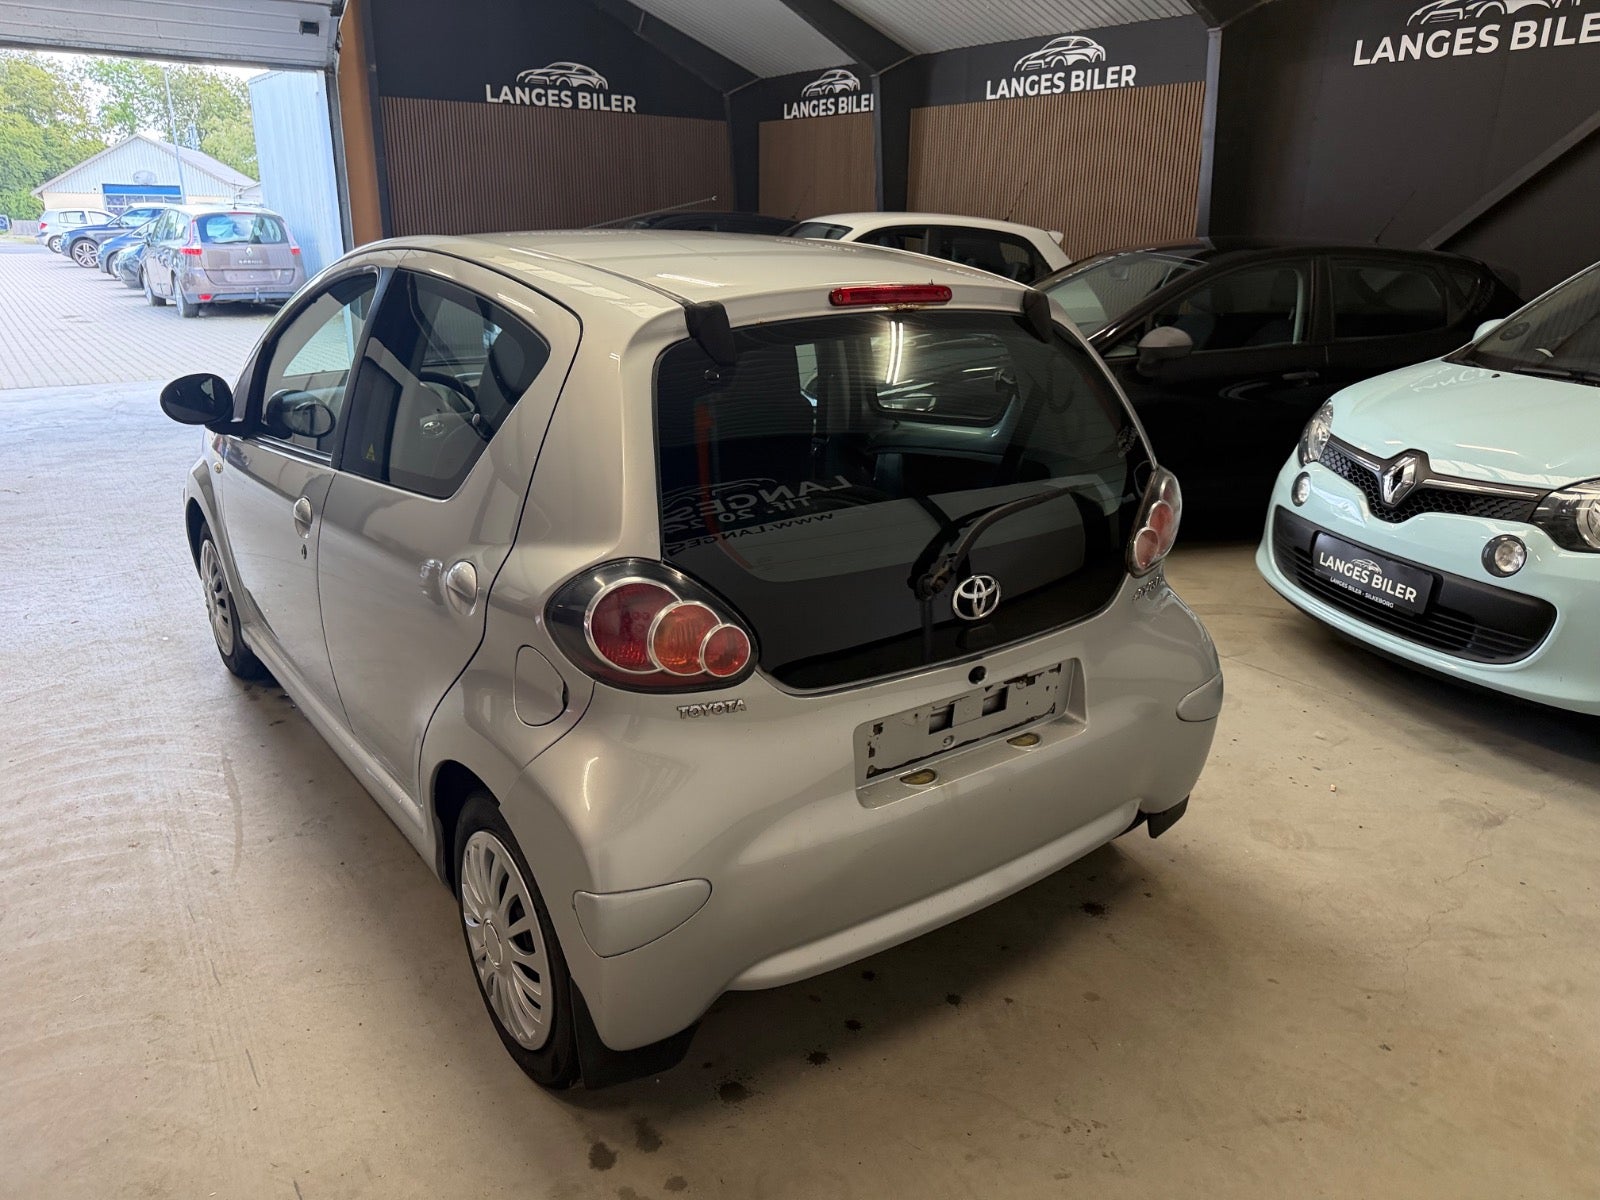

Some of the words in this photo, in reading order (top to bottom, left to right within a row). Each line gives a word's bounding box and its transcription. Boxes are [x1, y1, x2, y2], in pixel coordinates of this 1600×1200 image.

[1353, 23, 1501, 66] LANGES
[485, 84, 573, 108] LANGES
[577, 91, 637, 113] BILER
[986, 72, 1065, 100] LANGES
[1070, 65, 1137, 92] BILER
[784, 98, 835, 120] LANGES
[1319, 552, 1369, 584] LANGES
[1371, 574, 1417, 603] BILER
[1330, 576, 1348, 589] LANGES
[1347, 584, 1362, 596] BILER
[1364, 592, 1394, 608] SILKEBORG
[677, 698, 747, 719] TOYOTA
